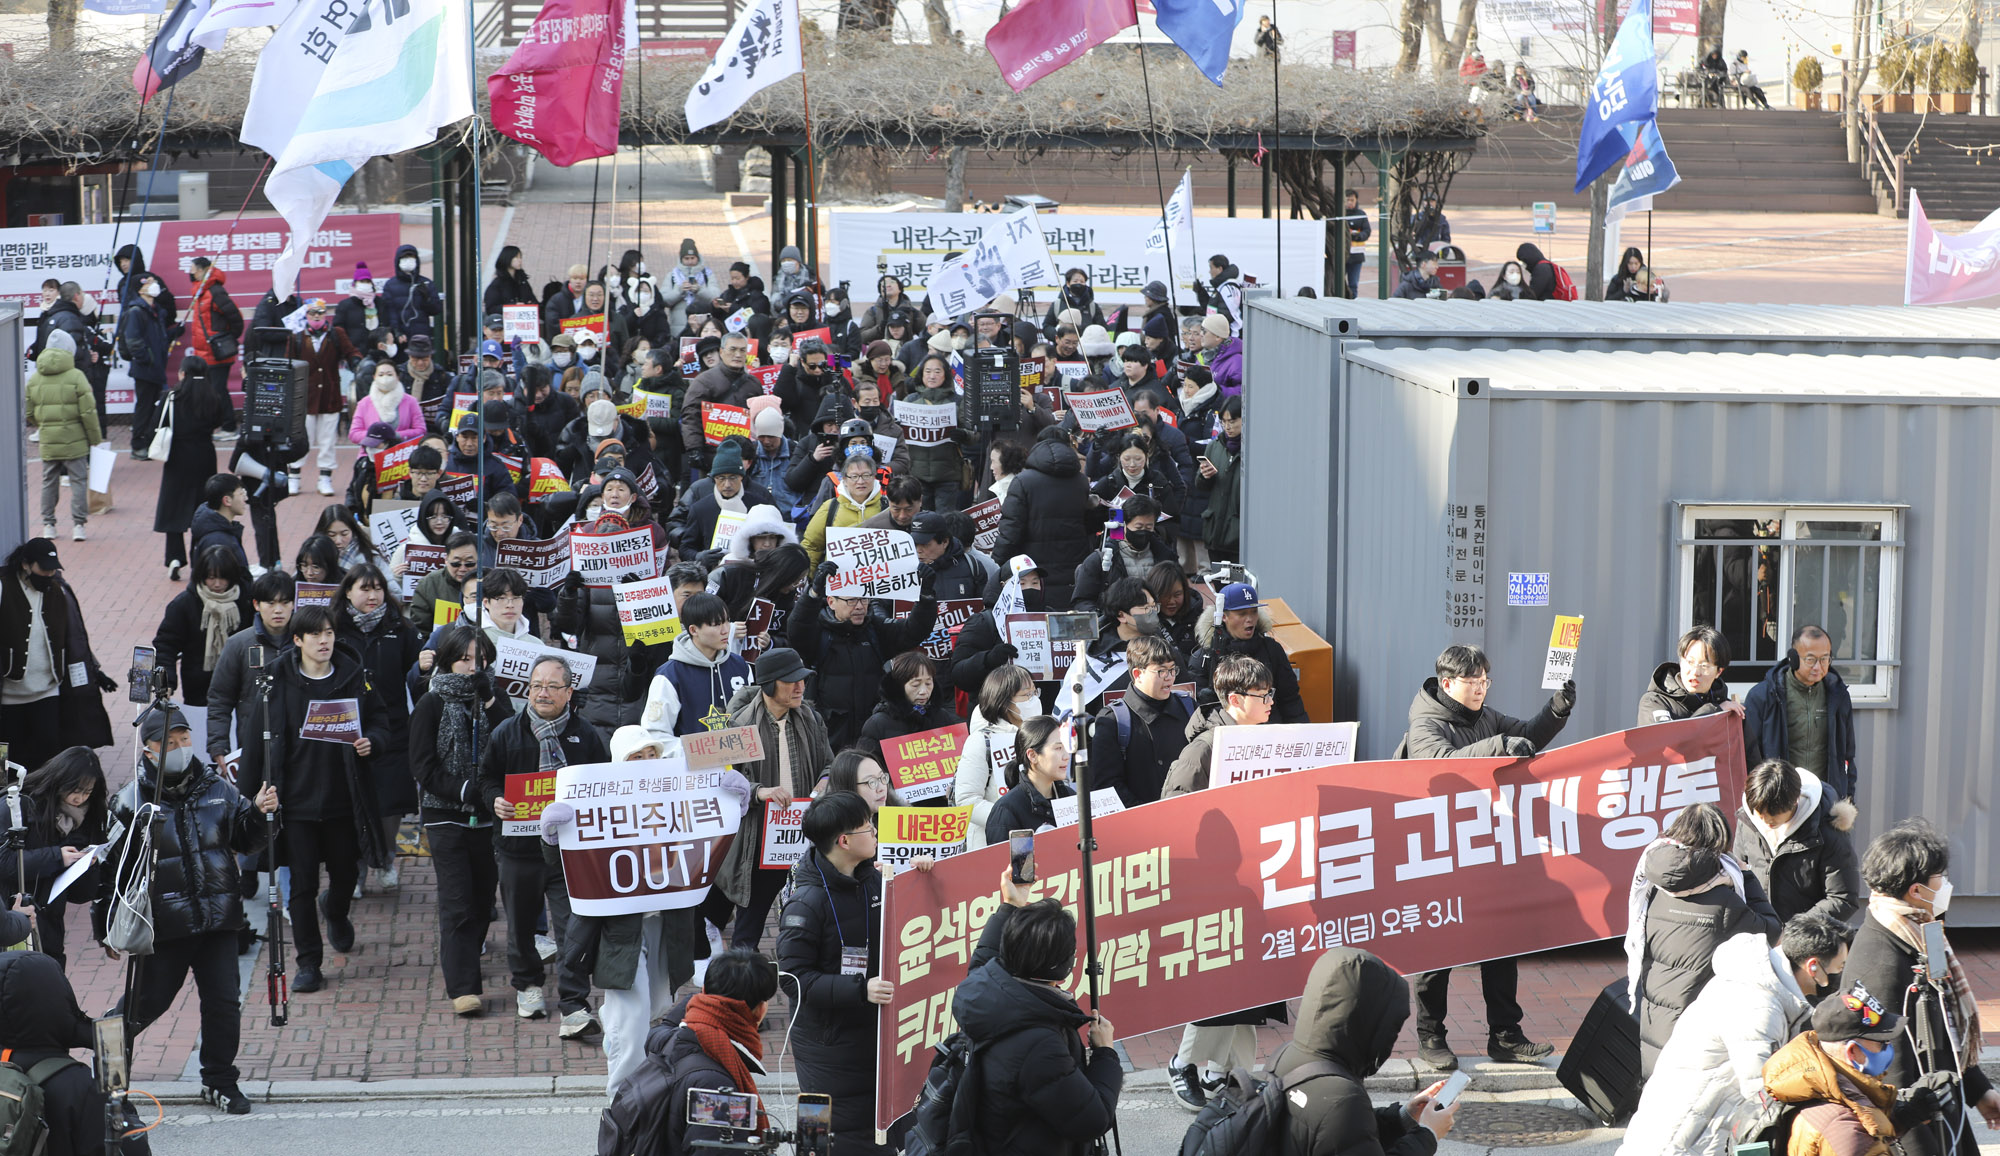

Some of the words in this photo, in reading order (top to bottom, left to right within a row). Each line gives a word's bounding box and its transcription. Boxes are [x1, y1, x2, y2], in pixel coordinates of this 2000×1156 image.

[891, 226, 984, 251] 내란수괴
[0, 257, 27, 271] 들은
[248, 252, 334, 271] 응원니다
[1093, 394, 1124, 408] 내란동조
[899, 413, 951, 426] 반민주세력
[908, 427, 946, 442] OUT!
[573, 541, 610, 557] 계엄옹호
[610, 534, 651, 554] 내란동조
[827, 529, 890, 559] 민주광장
[853, 540, 916, 569] 지켜내고
[498, 553, 546, 568] 내란수괴
[579, 558, 608, 572] 고대가
[608, 551, 649, 569] 막아내자
[582, 575, 614, 584] 려대학교
[827, 562, 891, 592] 열사정신
[624, 586, 668, 602] 민주광장에서
[1242, 588, 1253, 600] LA
[637, 626, 674, 640] 민주동우회
[1016, 629, 1046, 638] 계엄규탄
[924, 641, 953, 660] 지켜
[1020, 640, 1044, 651] 압도적
[1025, 653, 1041, 662] 가결
[689, 735, 718, 756] 내란
[899, 732, 956, 761] 내란수괴
[1225, 744, 1274, 762] 고려대학교
[1274, 742, 1314, 758] 학생들이
[1314, 740, 1348, 757] 말한다!
[898, 761, 941, 785] 윤석열
[563, 779, 634, 801] 고려대학교
[638, 775, 683, 791] 학생들이
[684, 771, 726, 790] 말한다
[905, 785, 941, 800] 고려대학교
[575, 797, 725, 842] 반민주세력
[897, 811, 969, 843] 내란옹호
[1258, 807, 1375, 910] 긴급
[1394, 776, 1582, 882] 고려대
[1596, 755, 1721, 851] 행동
[608, 840, 712, 894] OUT!
[1094, 846, 1171, 918] 파면!
[1260, 927, 1296, 962] 2월
[1300, 912, 1376, 950] 21일(금)
[1380, 903, 1424, 938] 오후
[1426, 896, 1464, 930] 3시
[896, 985, 961, 1065] 쿠데
[1159, 907, 1244, 981] 규탄!
